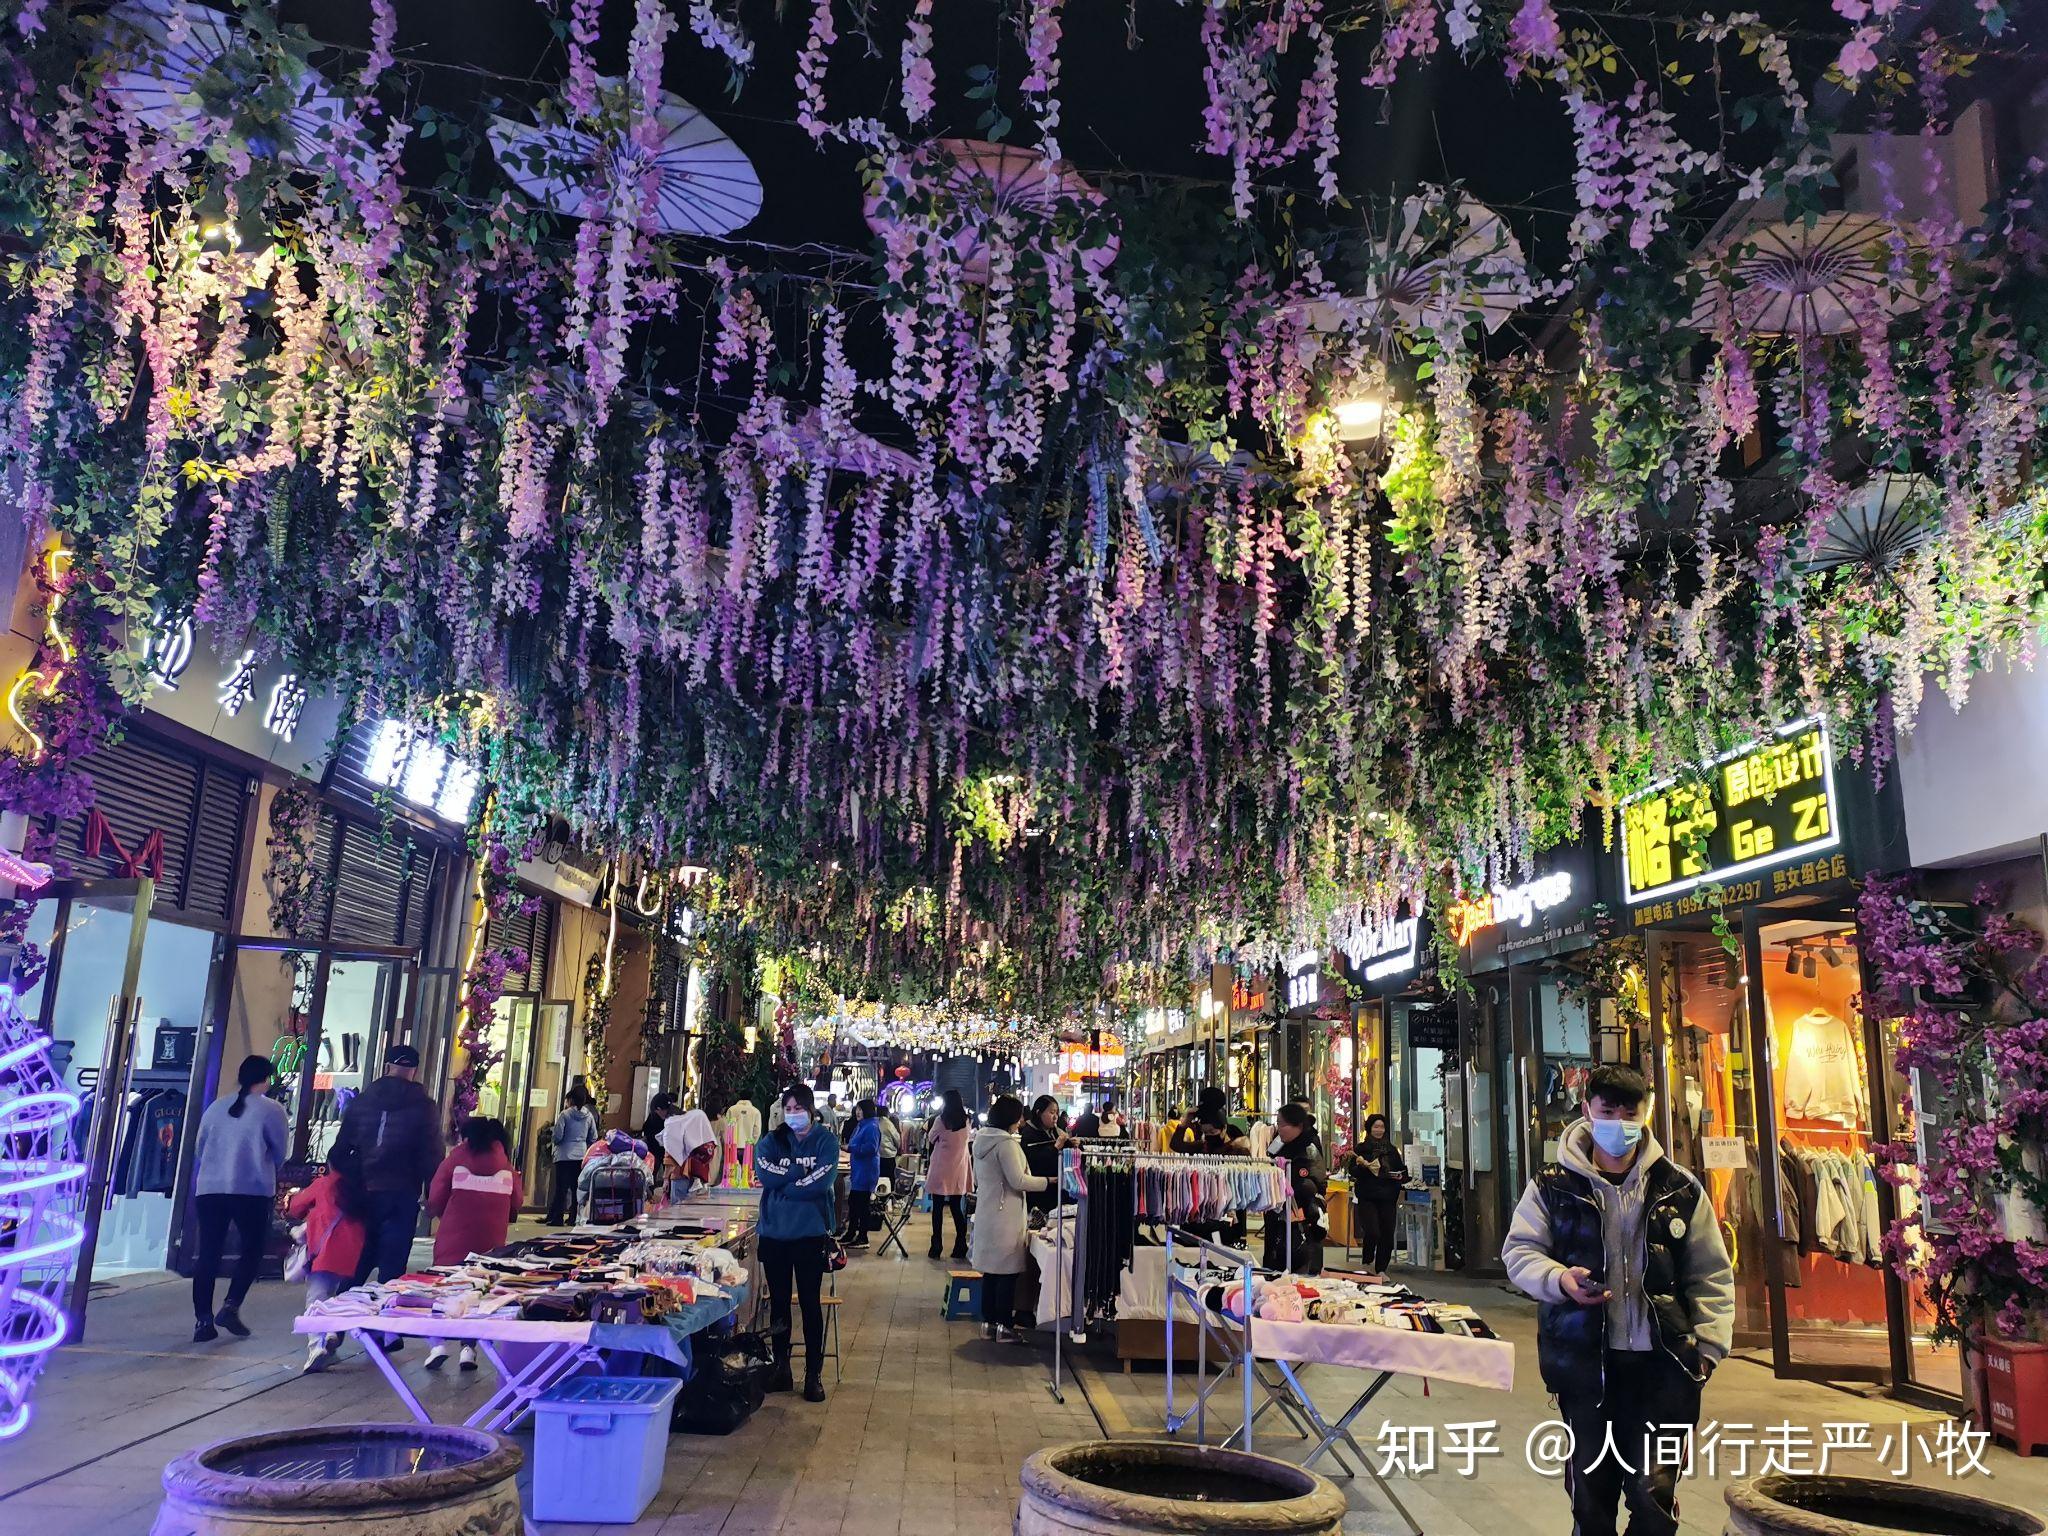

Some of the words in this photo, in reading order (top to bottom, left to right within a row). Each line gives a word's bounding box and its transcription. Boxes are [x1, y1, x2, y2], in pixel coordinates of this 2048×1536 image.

[1725, 731, 1825, 807] 原创设计
[1731, 818, 1774, 862] Ge
[1792, 793, 1831, 842] Zi
[1634, 901, 1674, 927] 加盟电话
[1676, 879, 1763, 917] 199242297
